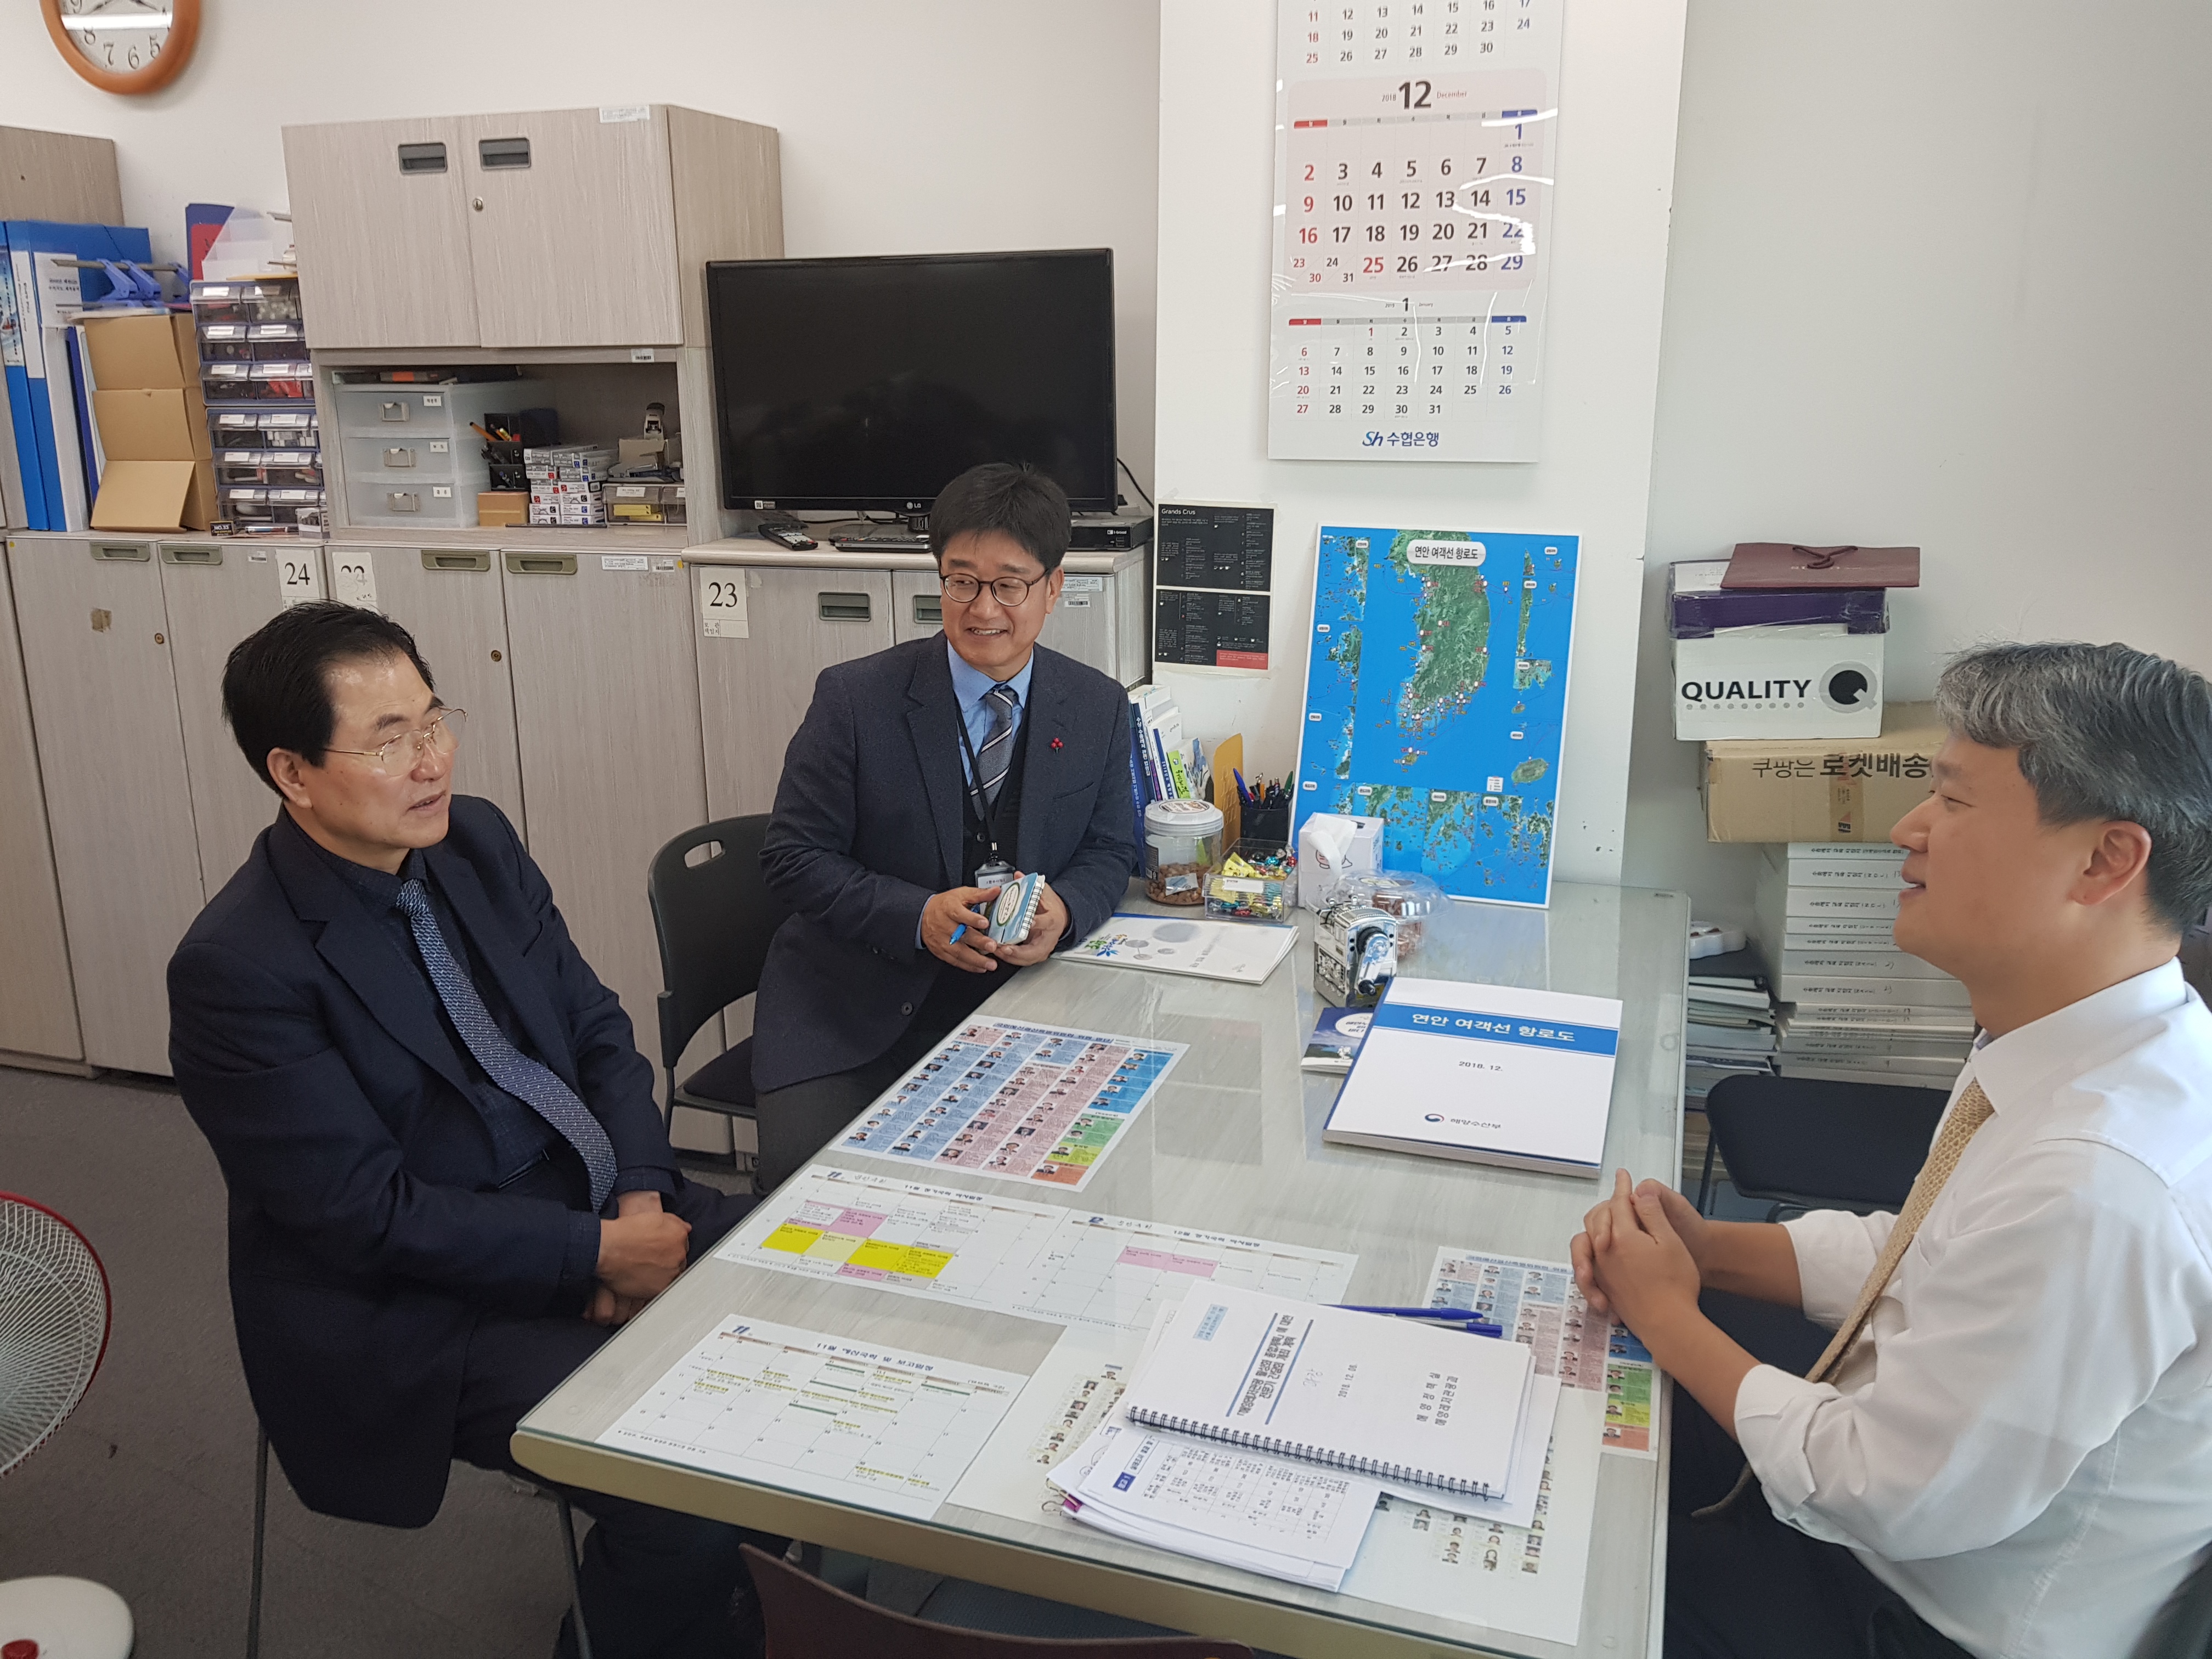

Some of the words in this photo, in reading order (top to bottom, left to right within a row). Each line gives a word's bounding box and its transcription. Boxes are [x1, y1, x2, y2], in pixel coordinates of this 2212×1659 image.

[1308, 10, 1318, 22] 11
[1342, 9, 1353, 21] 12
[1376, 7, 1389, 18] 13
[1412, 4, 1424, 16] 14
[1447, 3, 1459, 13] 15
[1483, 0, 1495, 11] 16
[1307, 32, 1319, 43] 18
[1341, 30, 1353, 41] 19
[1375, 28, 1389, 40] 20
[1410, 25, 1422, 37] 21
[1445, 23, 1458, 35] 22
[1481, 21, 1494, 32] 23
[1516, 19, 1530, 30] 24
[103, 41, 114, 66] 7
[128, 44, 139, 69] 6
[149, 33, 160, 59] 5
[1306, 53, 1318, 64] 25
[1340, 51, 1353, 62] 26
[1374, 49, 1387, 60] 27
[1409, 47, 1422, 58] 28
[1444, 44, 1458, 55] 29
[1480, 43, 1493, 54] 30
[1398, 81, 1432, 110] 12
[1514, 123, 1522, 140] 1
[1304, 165, 1314, 182] 2
[1338, 163, 1348, 180] 3
[1371, 162, 1383, 178] 4
[1406, 161, 1417, 177] 5
[1441, 159, 1452, 176] 6
[1476, 157, 1487, 174] 7
[1511, 156, 1522, 172] 8
[1304, 196, 1314, 213] 9
[1333, 195, 1353, 212] 10
[1367, 194, 1385, 210] 11
[1401, 192, 1420, 209] 12
[1436, 191, 1455, 208] 13
[1470, 190, 1491, 207] 14
[1506, 189, 1526, 205] 15
[1299, 227, 1318, 244] 16
[1333, 227, 1351, 243] 17
[1365, 225, 1385, 242] 18
[1400, 224, 1419, 241] 19
[1432, 223, 1454, 240] 20
[1467, 222, 1488, 239] 21
[1293, 258, 1305, 268] 23
[1326, 257, 1339, 267] 24
[1363, 257, 1384, 274] 25
[1396, 256, 1418, 273] 26
[1431, 256, 1453, 272] 27
[1465, 255, 1488, 272] 28
[1500, 255, 1523, 270] 29
[1309, 273, 1321, 283] 30
[1342, 273, 1354, 283] 31
[1402, 297, 1409, 312] 1
[1368, 327, 1373, 337] 1
[1401, 326, 1408, 337] 2
[1435, 326, 1442, 336] 3
[1469, 326, 1477, 336] 4
[1505, 325, 1512, 335] 5
[1301, 347, 1307, 357] 6
[1334, 347, 1340, 357] 7
[1367, 347, 1373, 357] 8
[1400, 346, 1407, 356] 9
[1432, 346, 1444, 356] 10
[1466, 346, 1478, 356] 11
[1502, 346, 1514, 356] 12
[1298, 366, 1310, 376] 13
[1330, 366, 1342, 376] 14
[1364, 366, 1375, 376] 15
[1397, 366, 1409, 376] 16
[1431, 365, 1443, 376] 17
[1465, 365, 1477, 376] 18
[1501, 365, 1513, 375] 19
[1297, 385, 1310, 396] 20
[1329, 385, 1341, 395] 21
[1362, 385, 1375, 395] 22
[1396, 385, 1408, 395] 23
[1429, 385, 1442, 395] 24
[1464, 385, 1477, 395] 25
[1498, 385, 1512, 395] 26
[1297, 404, 1308, 414] 27
[1329, 404, 1341, 414] 28
[1362, 404, 1374, 414] 29
[1395, 404, 1408, 414] 30
[1429, 404, 1441, 414] 31
[1362, 431, 1384, 447] Sh
[1386, 431, 1440, 448] 수협은행
[1414, 546, 1430, 558] 연안
[1431, 546, 1454, 560] 여객선
[1456, 548, 1479, 560] 항로도
[285, 562, 310, 585] 24
[709, 582, 737, 607] 23
[1681, 679, 1812, 702] QUALITY
[1752, 758, 1816, 778] 쿠팡은
[1820, 753, 1931, 778] 로켓배송
[1412, 1014, 1449, 1026] 연안
[1455, 1018, 1511, 1034] 여객선
[1519, 1026, 1576, 1042] 항로도
[1459, 1061, 1485, 1069] 2018.
[1451, 1118, 1502, 1129] 해양수산부
